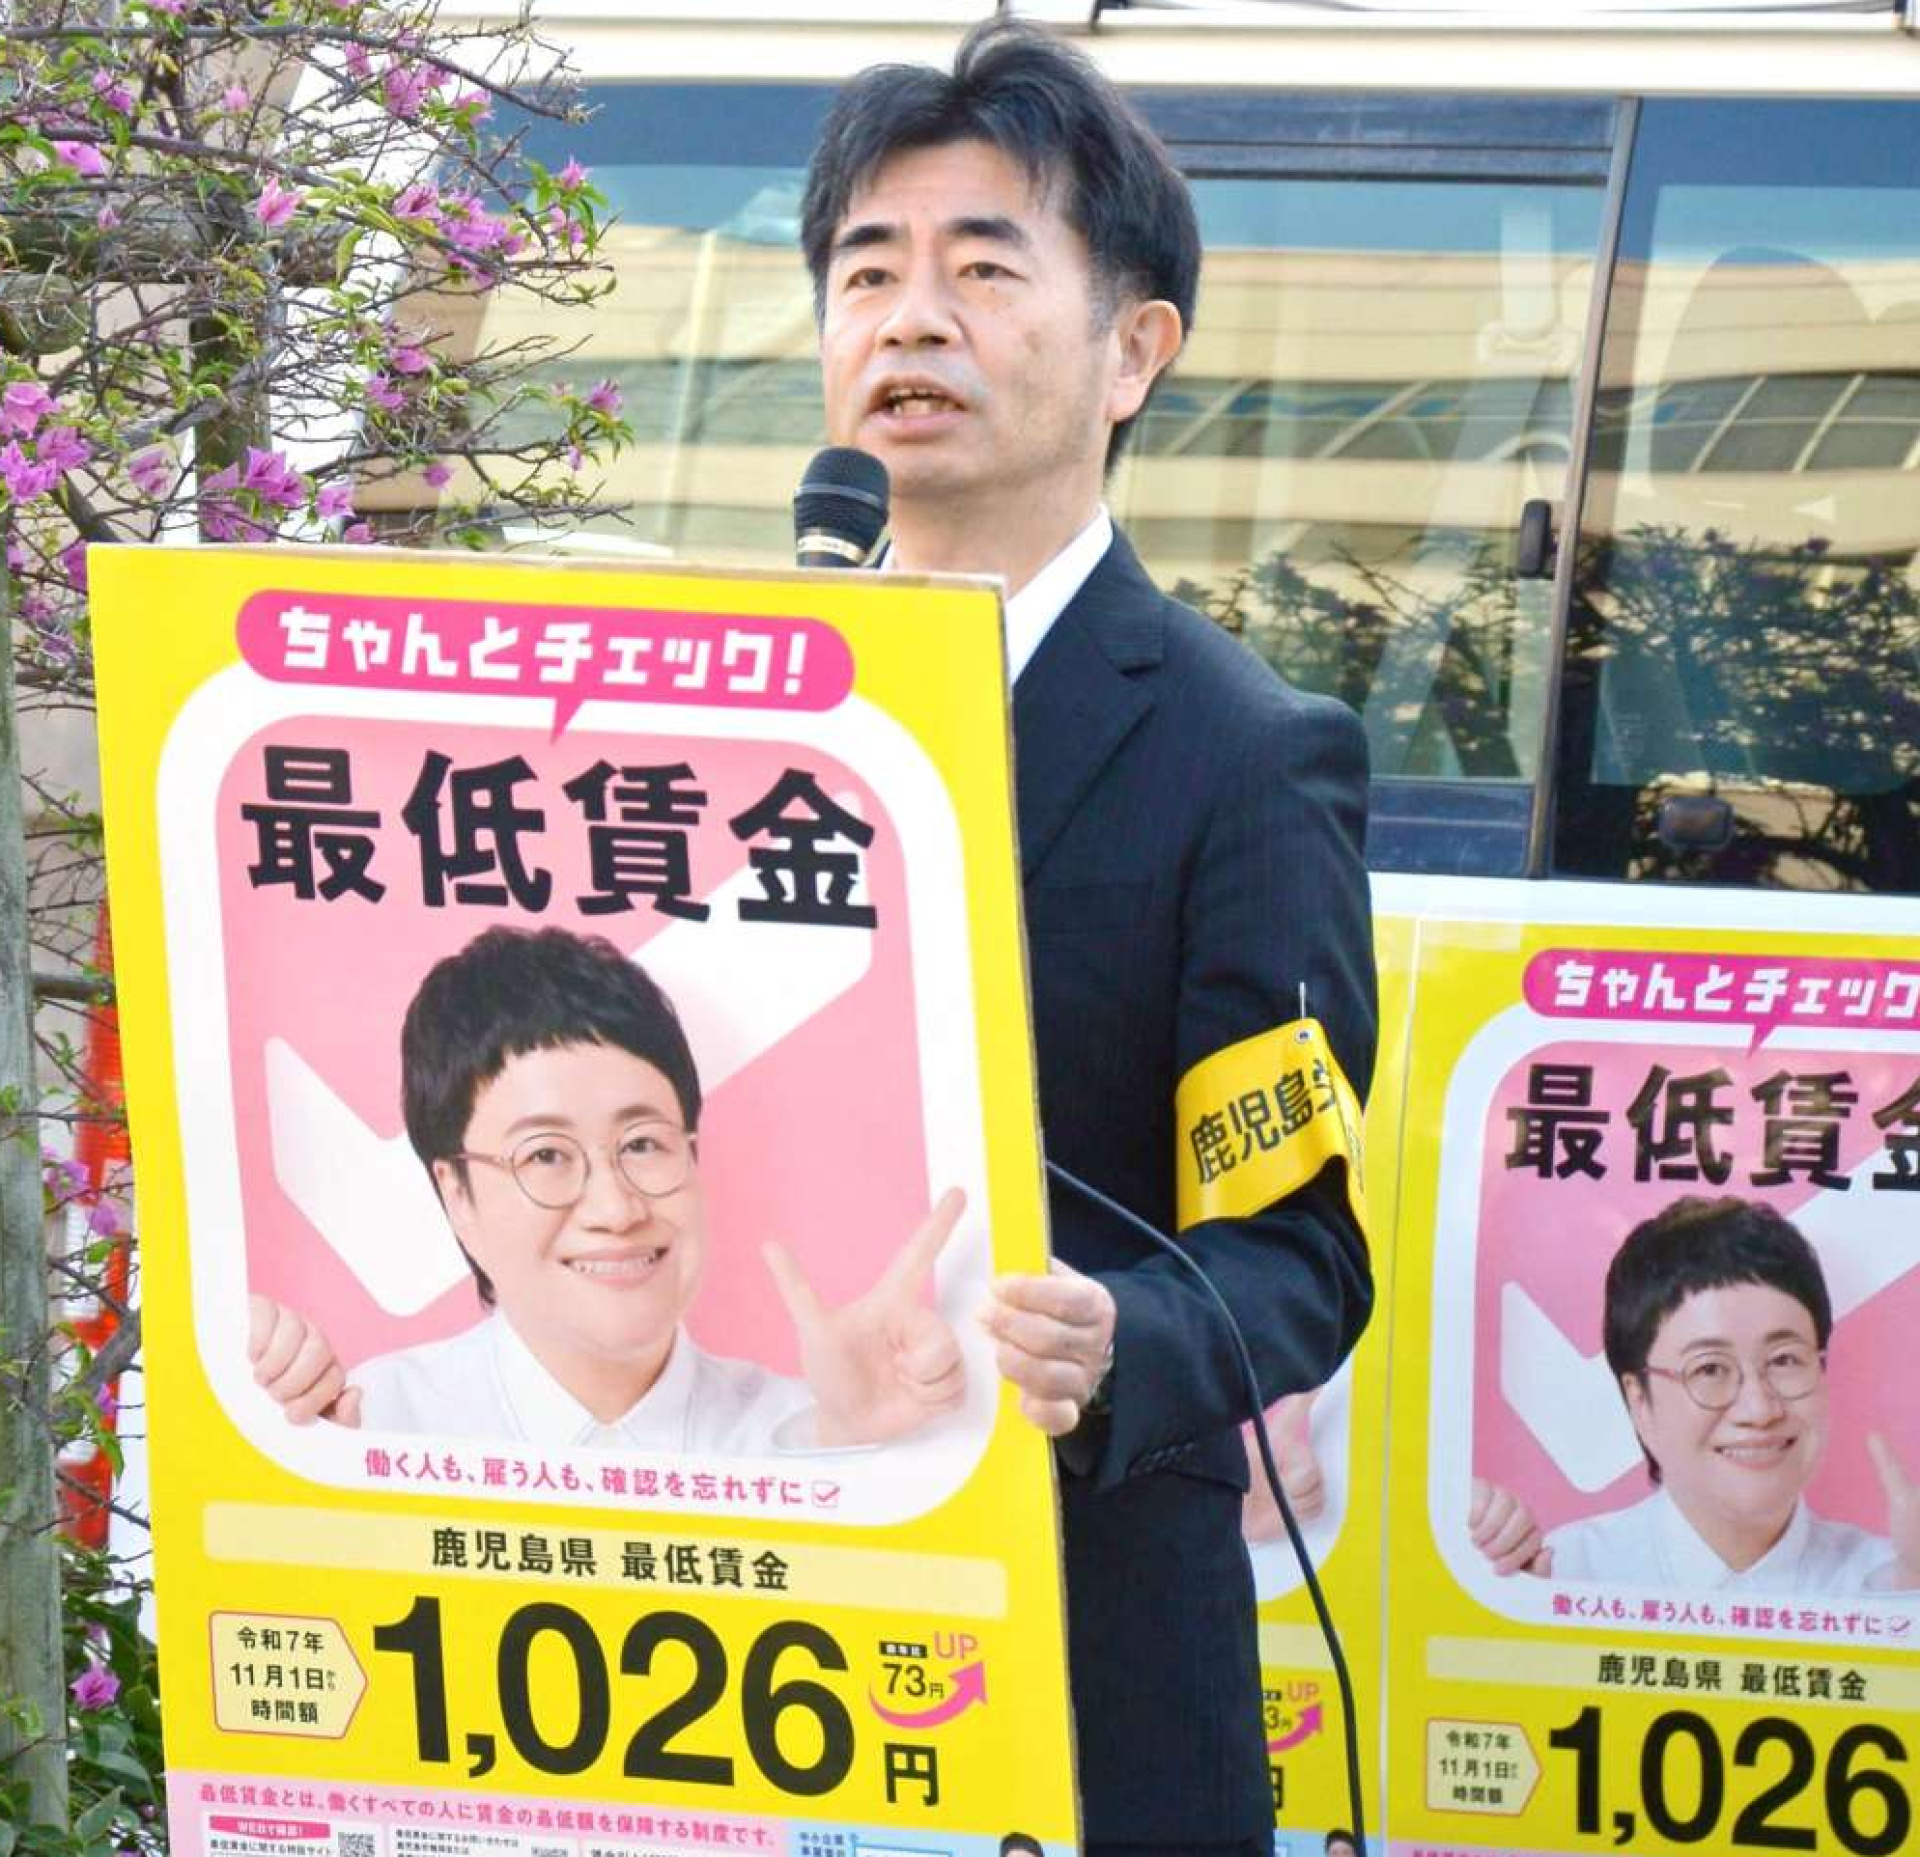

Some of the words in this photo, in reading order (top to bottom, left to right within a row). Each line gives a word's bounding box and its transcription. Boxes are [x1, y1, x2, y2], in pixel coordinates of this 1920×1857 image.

[280, 605, 809, 695] ちゃんとチェック!
[240, 745, 879, 929] 最低賃金
[364, 1447, 804, 1505] 働く人も、雇う人も、確認を忘れずに
[432, 1527, 598, 1577] 鹿児島県
[622, 1541, 790, 1591] 最低賃金
[237, 1626, 325, 1654] 令和7年
[934, 1631, 979, 1660] UP
[1287, 1681, 1320, 1701] UP
[1598, 1652, 1722, 1691] 鹿児島県
[1739, 1663, 1867, 1702] 最低賃金
[250, 1697, 319, 1724] 時間額
[1549, 1705, 1912, 1857] 1,026
